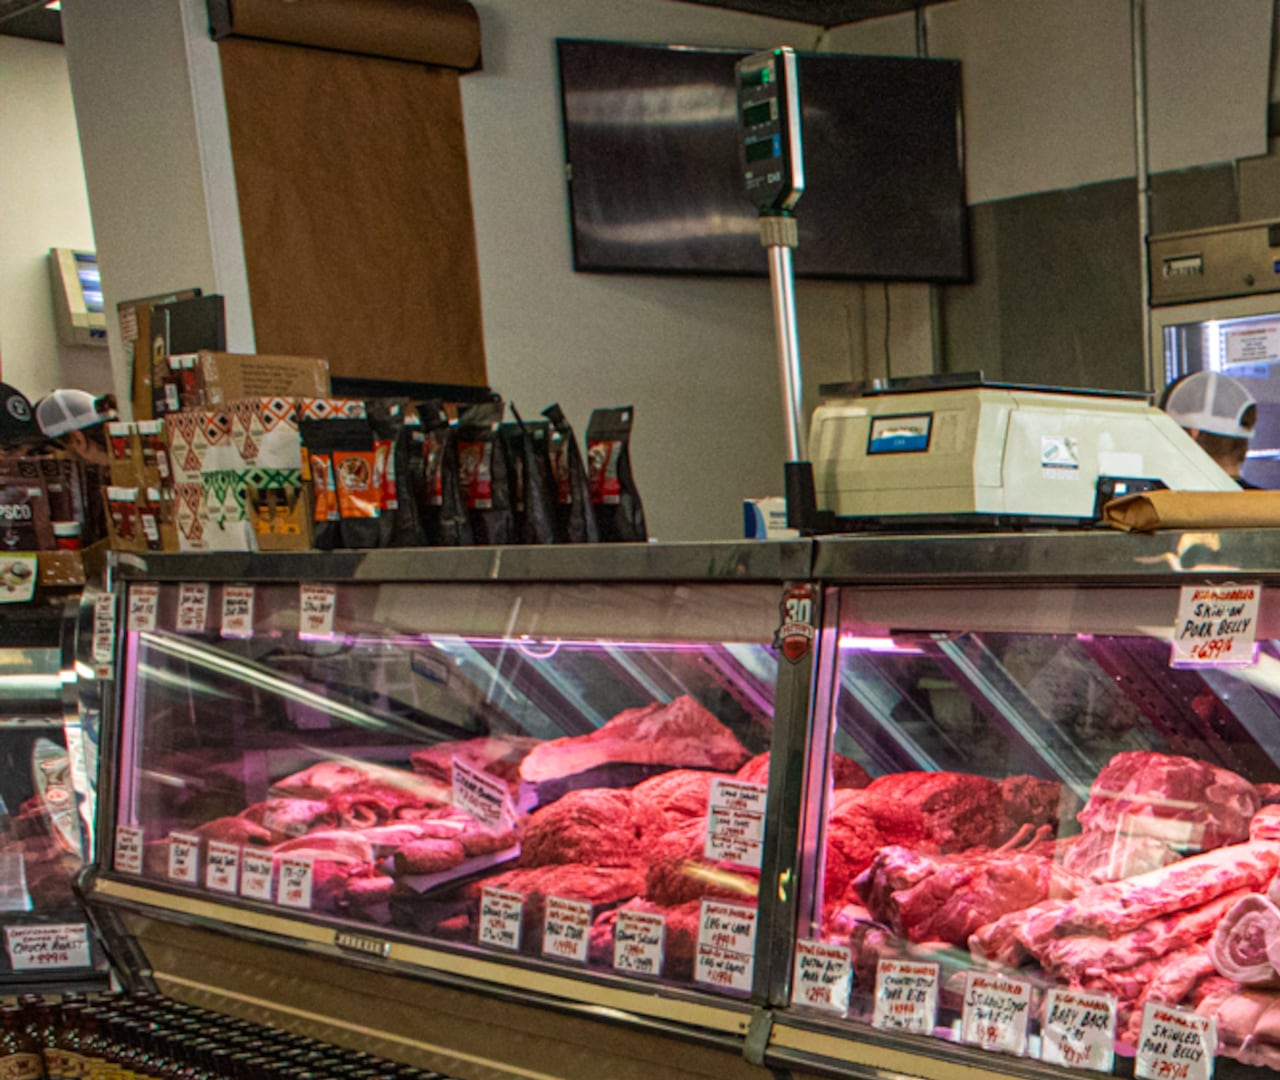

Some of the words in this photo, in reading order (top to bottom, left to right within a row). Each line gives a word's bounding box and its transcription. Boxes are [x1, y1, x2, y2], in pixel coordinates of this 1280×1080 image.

[785, 598, 812, 624] 30
[1181, 620, 1213, 639] PORK
[1216, 617, 1250, 634] BELLY
[1141, 1038, 1169, 1056] PORK
[1172, 1043, 1203, 1064] BELLY
